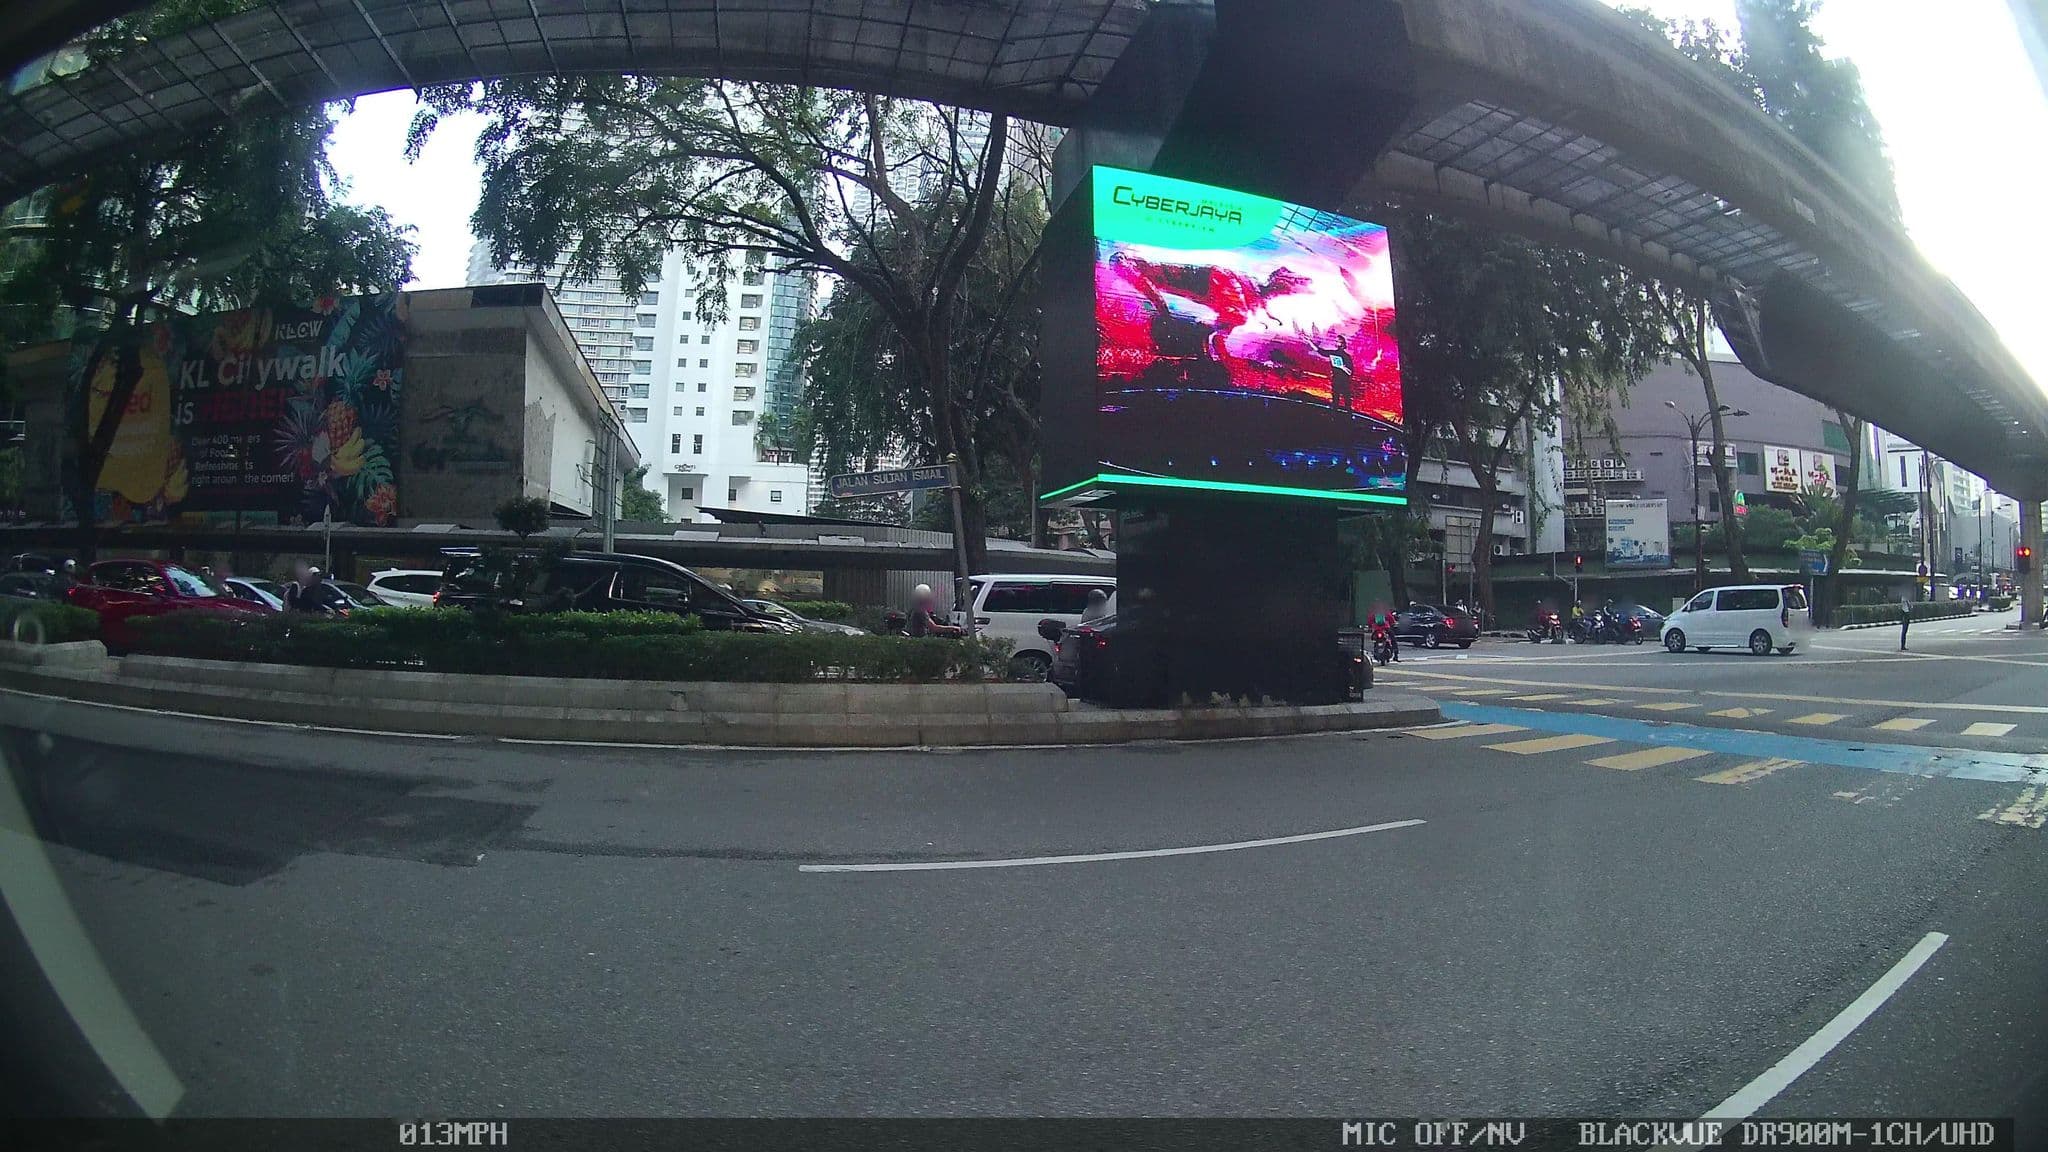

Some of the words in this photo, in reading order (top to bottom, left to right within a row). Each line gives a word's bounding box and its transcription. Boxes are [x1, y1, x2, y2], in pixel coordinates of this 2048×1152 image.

[179, 360, 210, 390] KL
[175, 395, 194, 425] is
[245, 473, 259, 484] the
[261, 472, 295, 484] corner!
[836, 477, 869, 489] JALAN
[873, 472, 908, 484] SULTAN
[912, 468, 945, 481] ISMAIL
